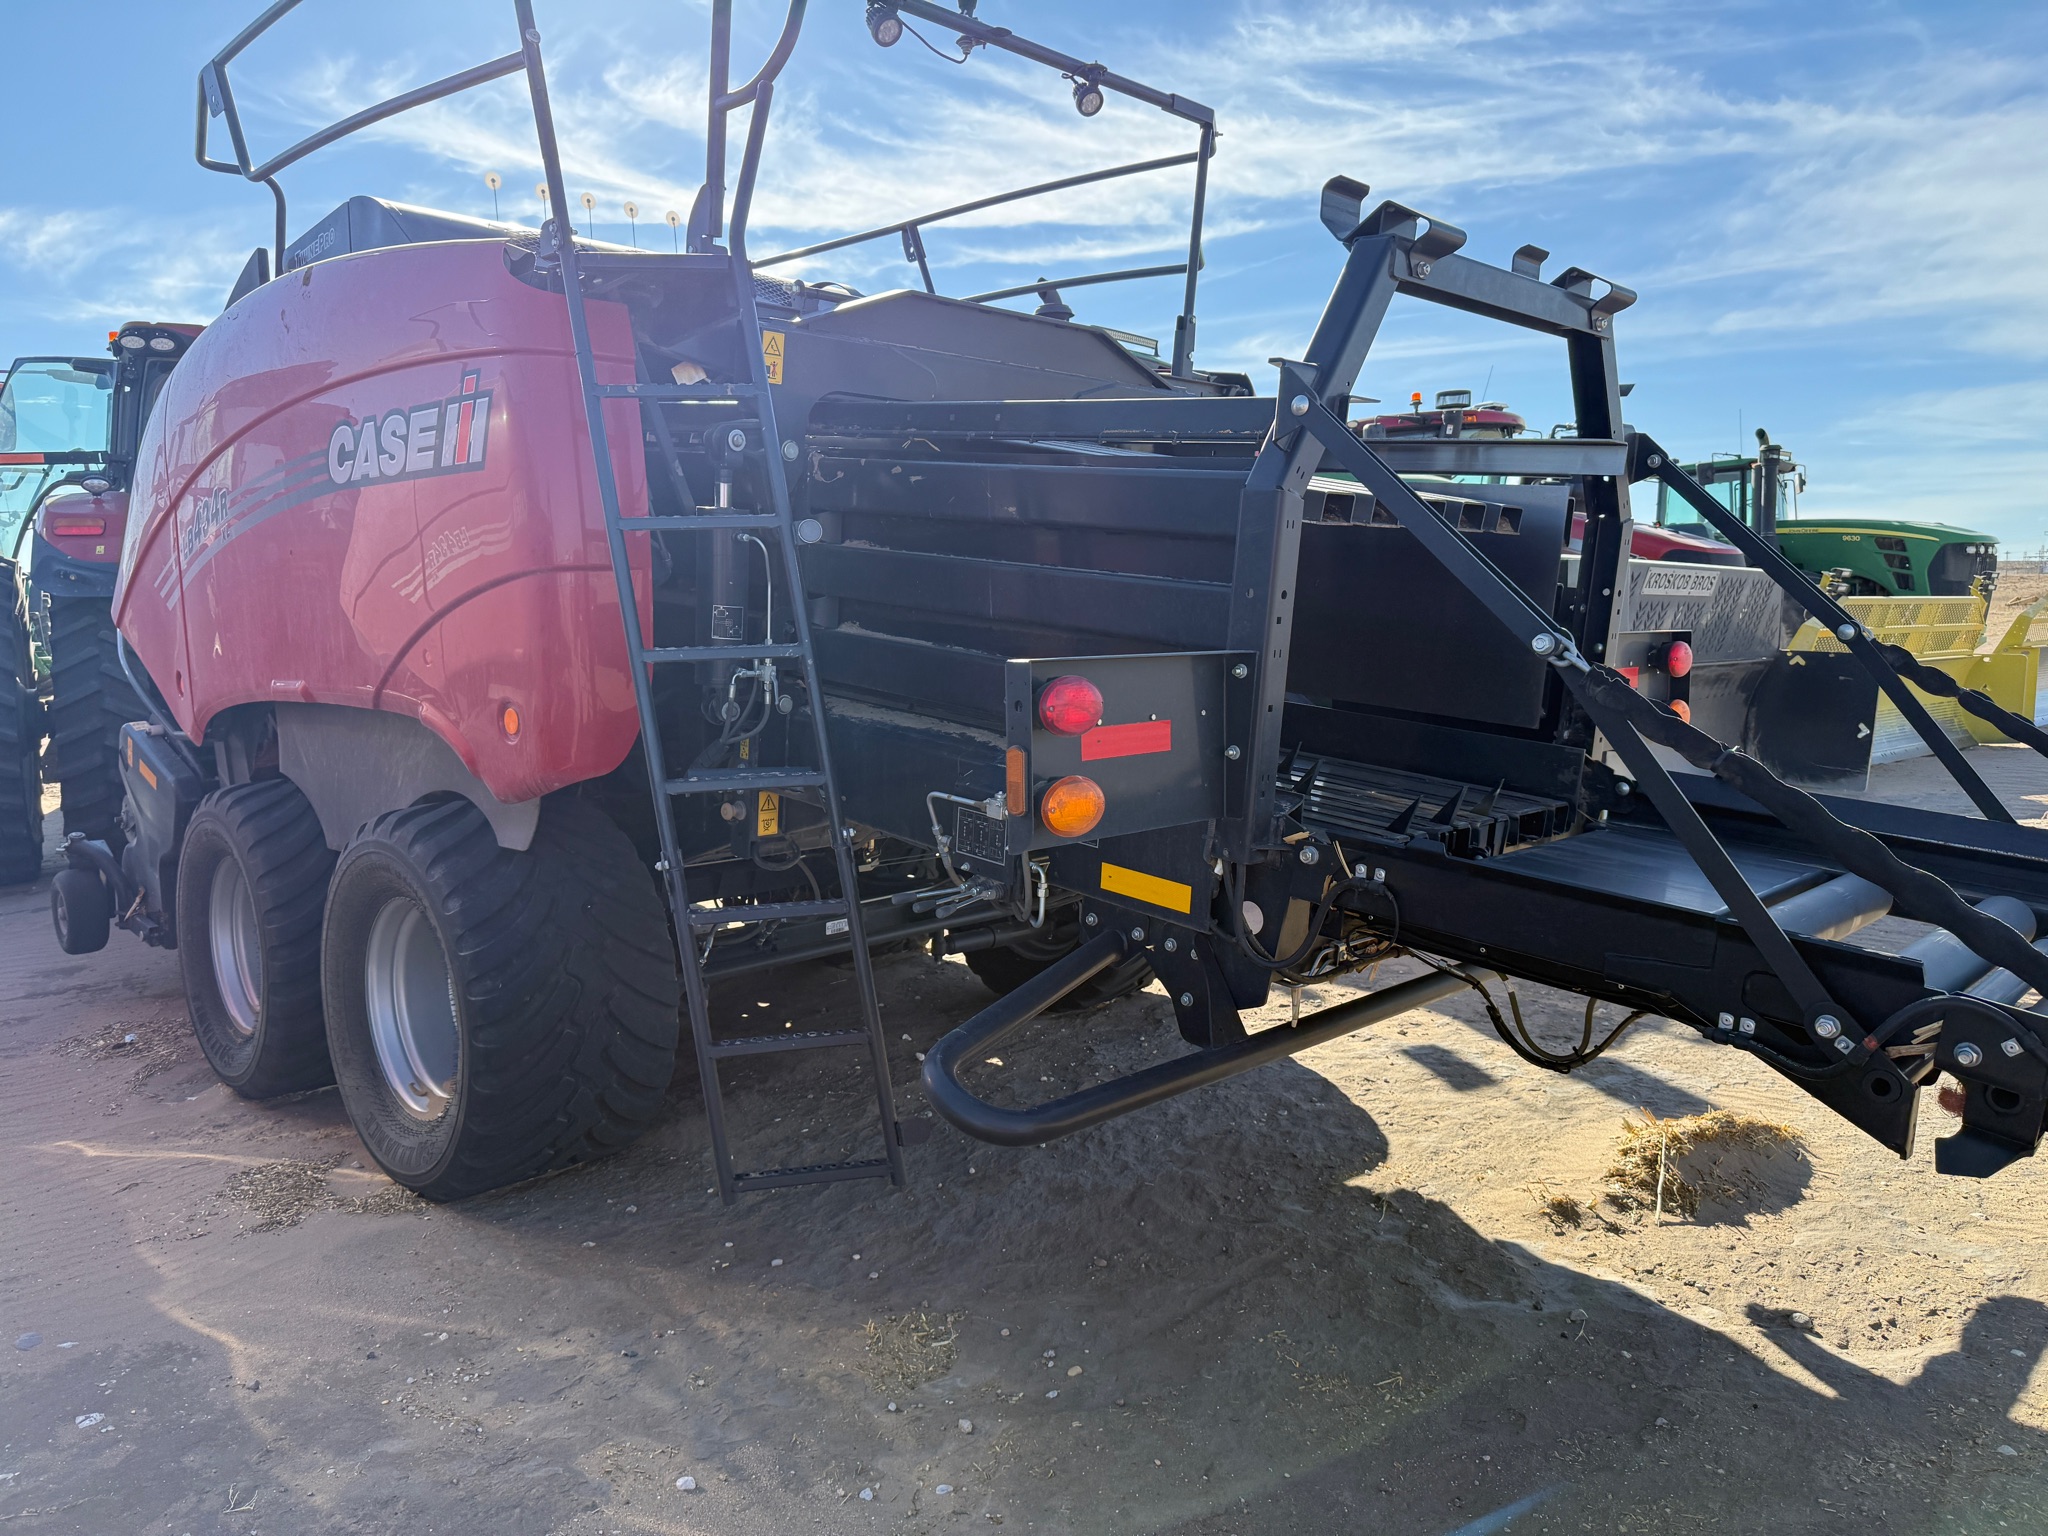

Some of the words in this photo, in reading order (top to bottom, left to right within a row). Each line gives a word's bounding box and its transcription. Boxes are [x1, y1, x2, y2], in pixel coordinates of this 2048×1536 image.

[328, 407, 439, 485] CASE
[1645, 572, 1691, 590] KROSKOB
[1690, 575, 1716, 590] BROS
